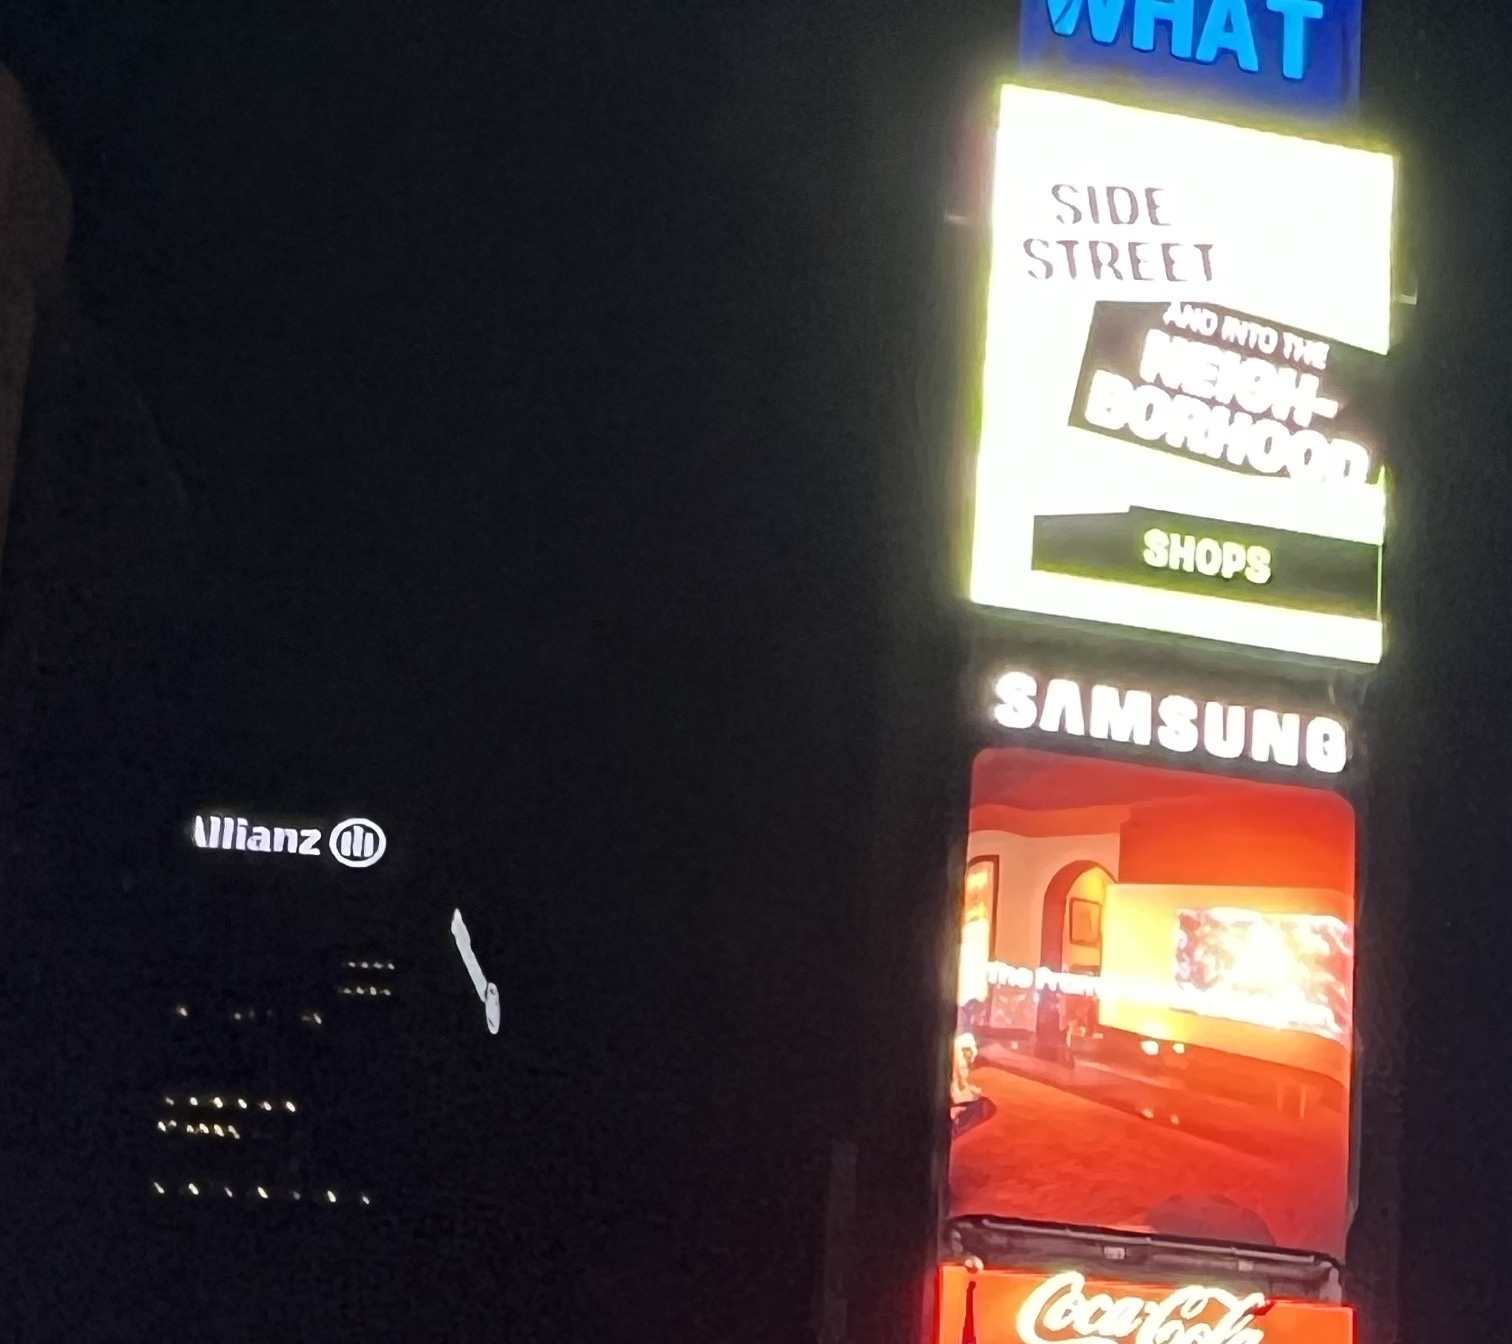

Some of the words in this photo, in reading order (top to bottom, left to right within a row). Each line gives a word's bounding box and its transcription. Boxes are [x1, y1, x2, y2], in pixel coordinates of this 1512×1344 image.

[1043, 0, 1324, 80] WHAT
[1050, 183, 1172, 227] SIDE
[1022, 237, 1214, 283] STREET
[1163, 302, 1218, 341] AND
[1219, 314, 1280, 356] INTO
[1281, 332, 1331, 370] THE
[1084, 369, 1370, 486] BORHOOD
[1142, 528, 1272, 586] SHOPS
[993, 670, 1349, 773] SAMSUNG
[192, 815, 321, 856] Allianz
